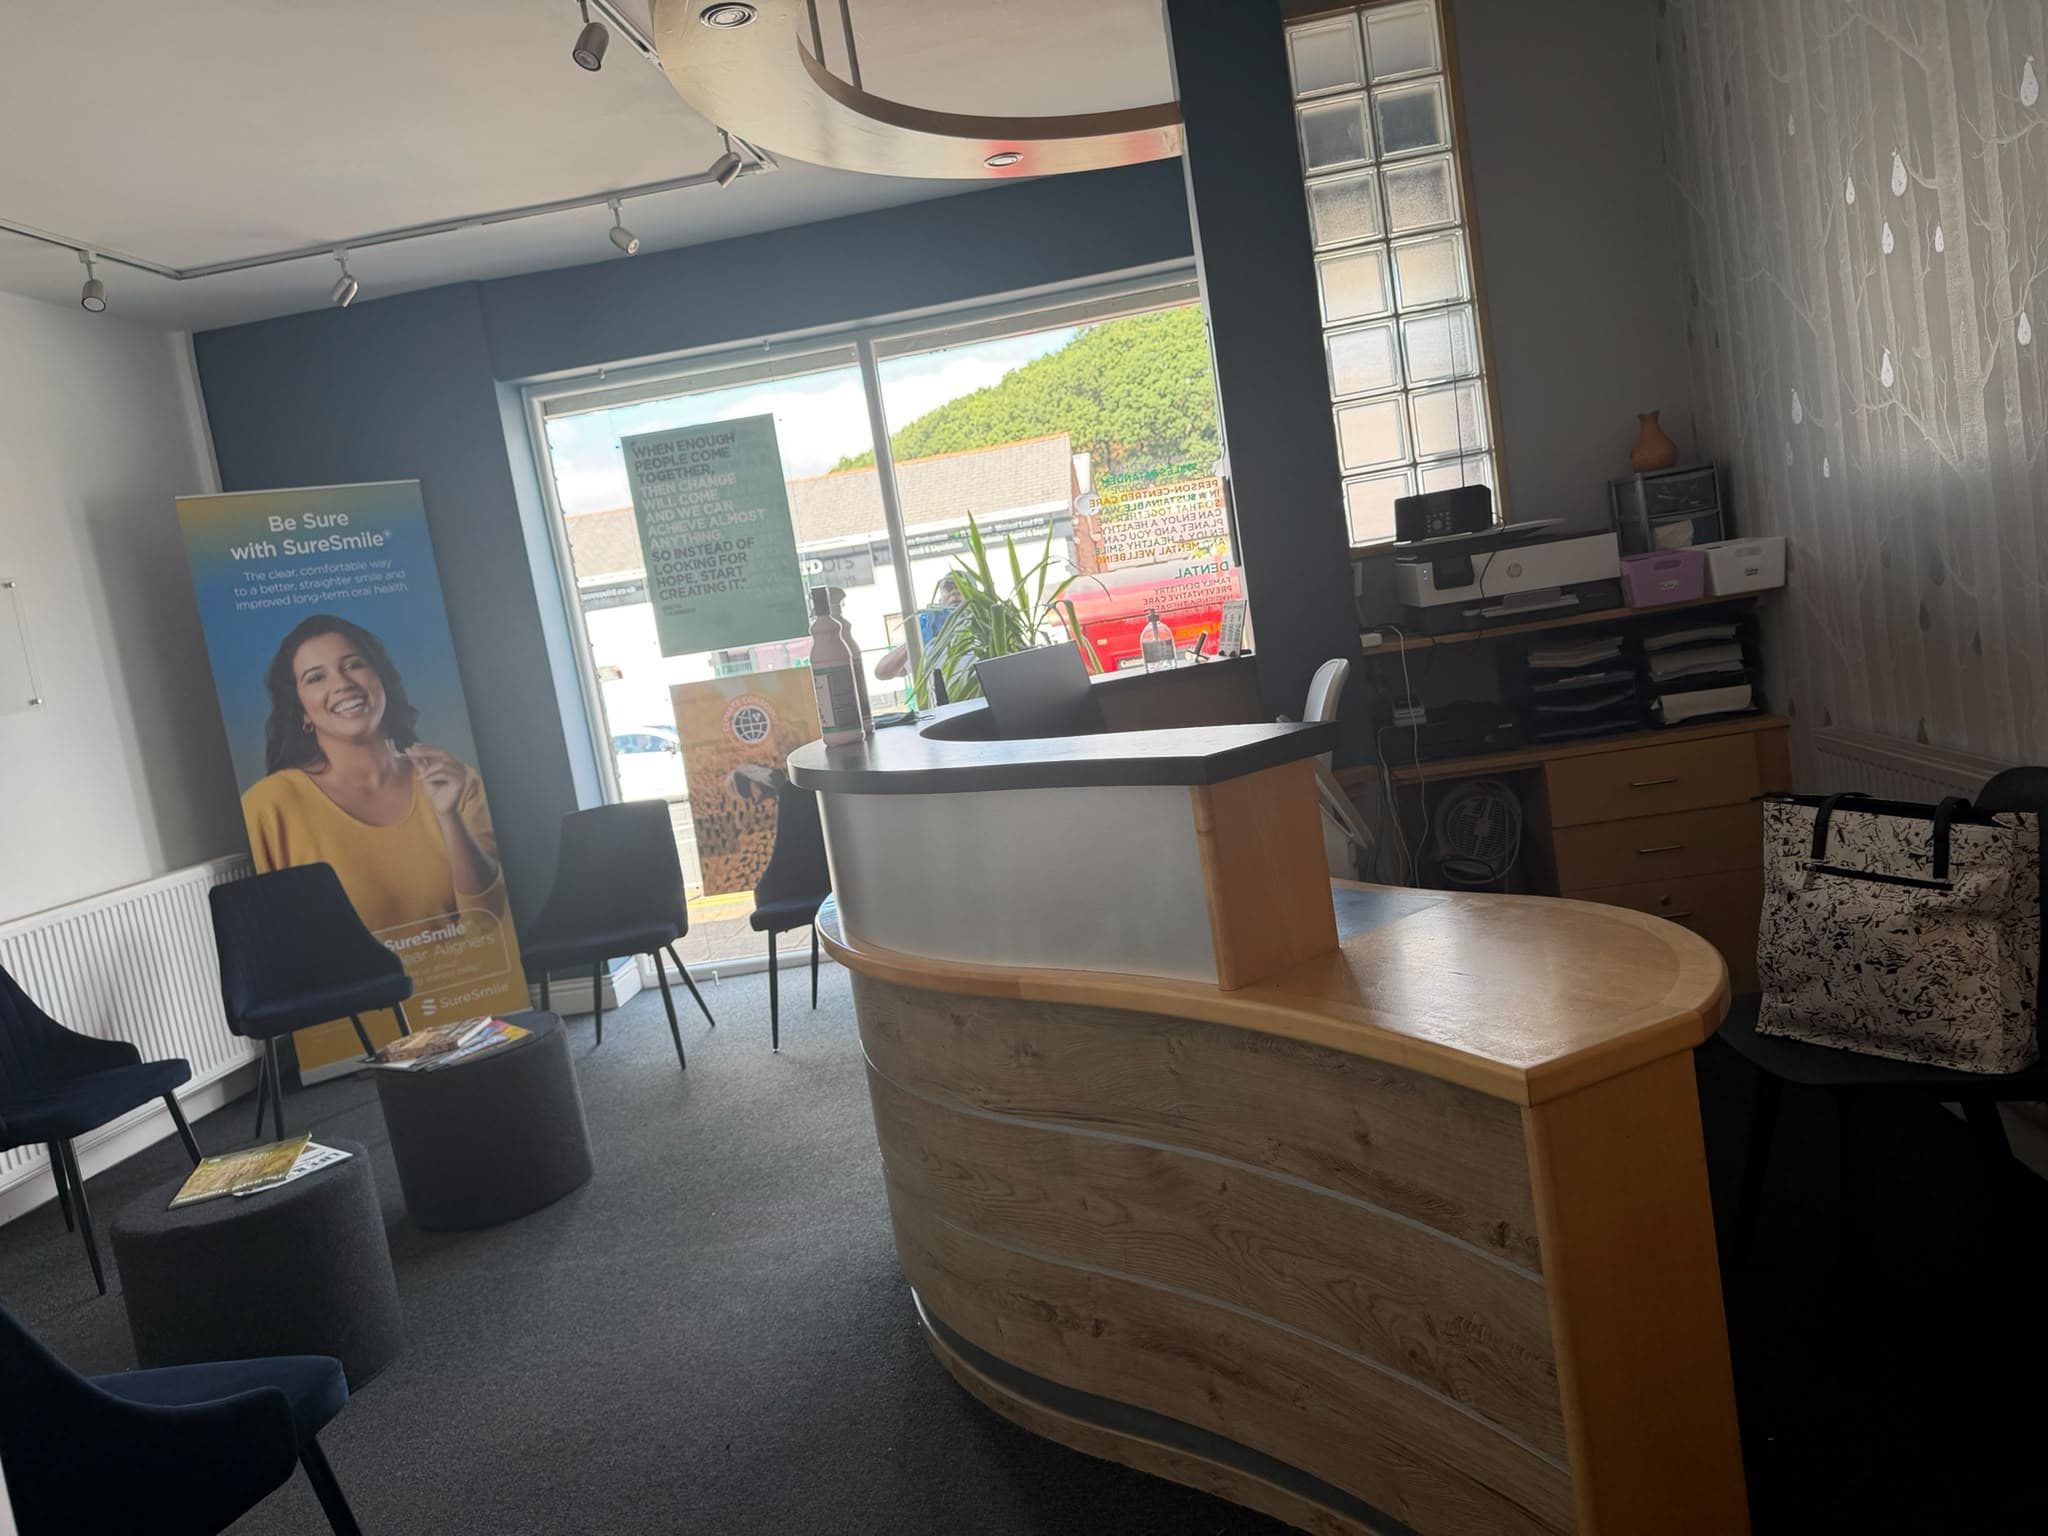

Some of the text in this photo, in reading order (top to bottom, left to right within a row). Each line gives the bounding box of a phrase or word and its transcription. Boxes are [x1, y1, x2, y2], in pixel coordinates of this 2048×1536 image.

[677, 432, 735, 451] ENOUGH
[635, 447, 730, 471] PEOPLE COME
[640, 474, 736, 498] THEN CHANGE
[642, 490, 719, 510] WILL COME
[268, 512, 349, 532] Be Sure
[646, 501, 733, 524] AND WE CAN
[649, 509, 767, 537] ACHIEVE ALMOST
[230, 540, 277, 561] with
[652, 537, 755, 563] SO INSTEAD OF
[244, 572, 265, 581] The
[301, 561, 367, 576] comfortable
[370, 560, 391, 570] way
[655, 552, 747, 575] LOOKING FOR
[700, 566, 743, 581] START
[234, 588, 247, 597] to
[250, 587, 258, 595] a
[299, 575, 351, 589] straighter
[354, 573, 382, 583] smile
[385, 569, 405, 579] and
[659, 581, 726, 601] CREATING
[236, 597, 290, 611] improved
[293, 588, 349, 604] long-term
[352, 586, 371, 597] oral
[440, 983, 508, 1008] SureSmile
